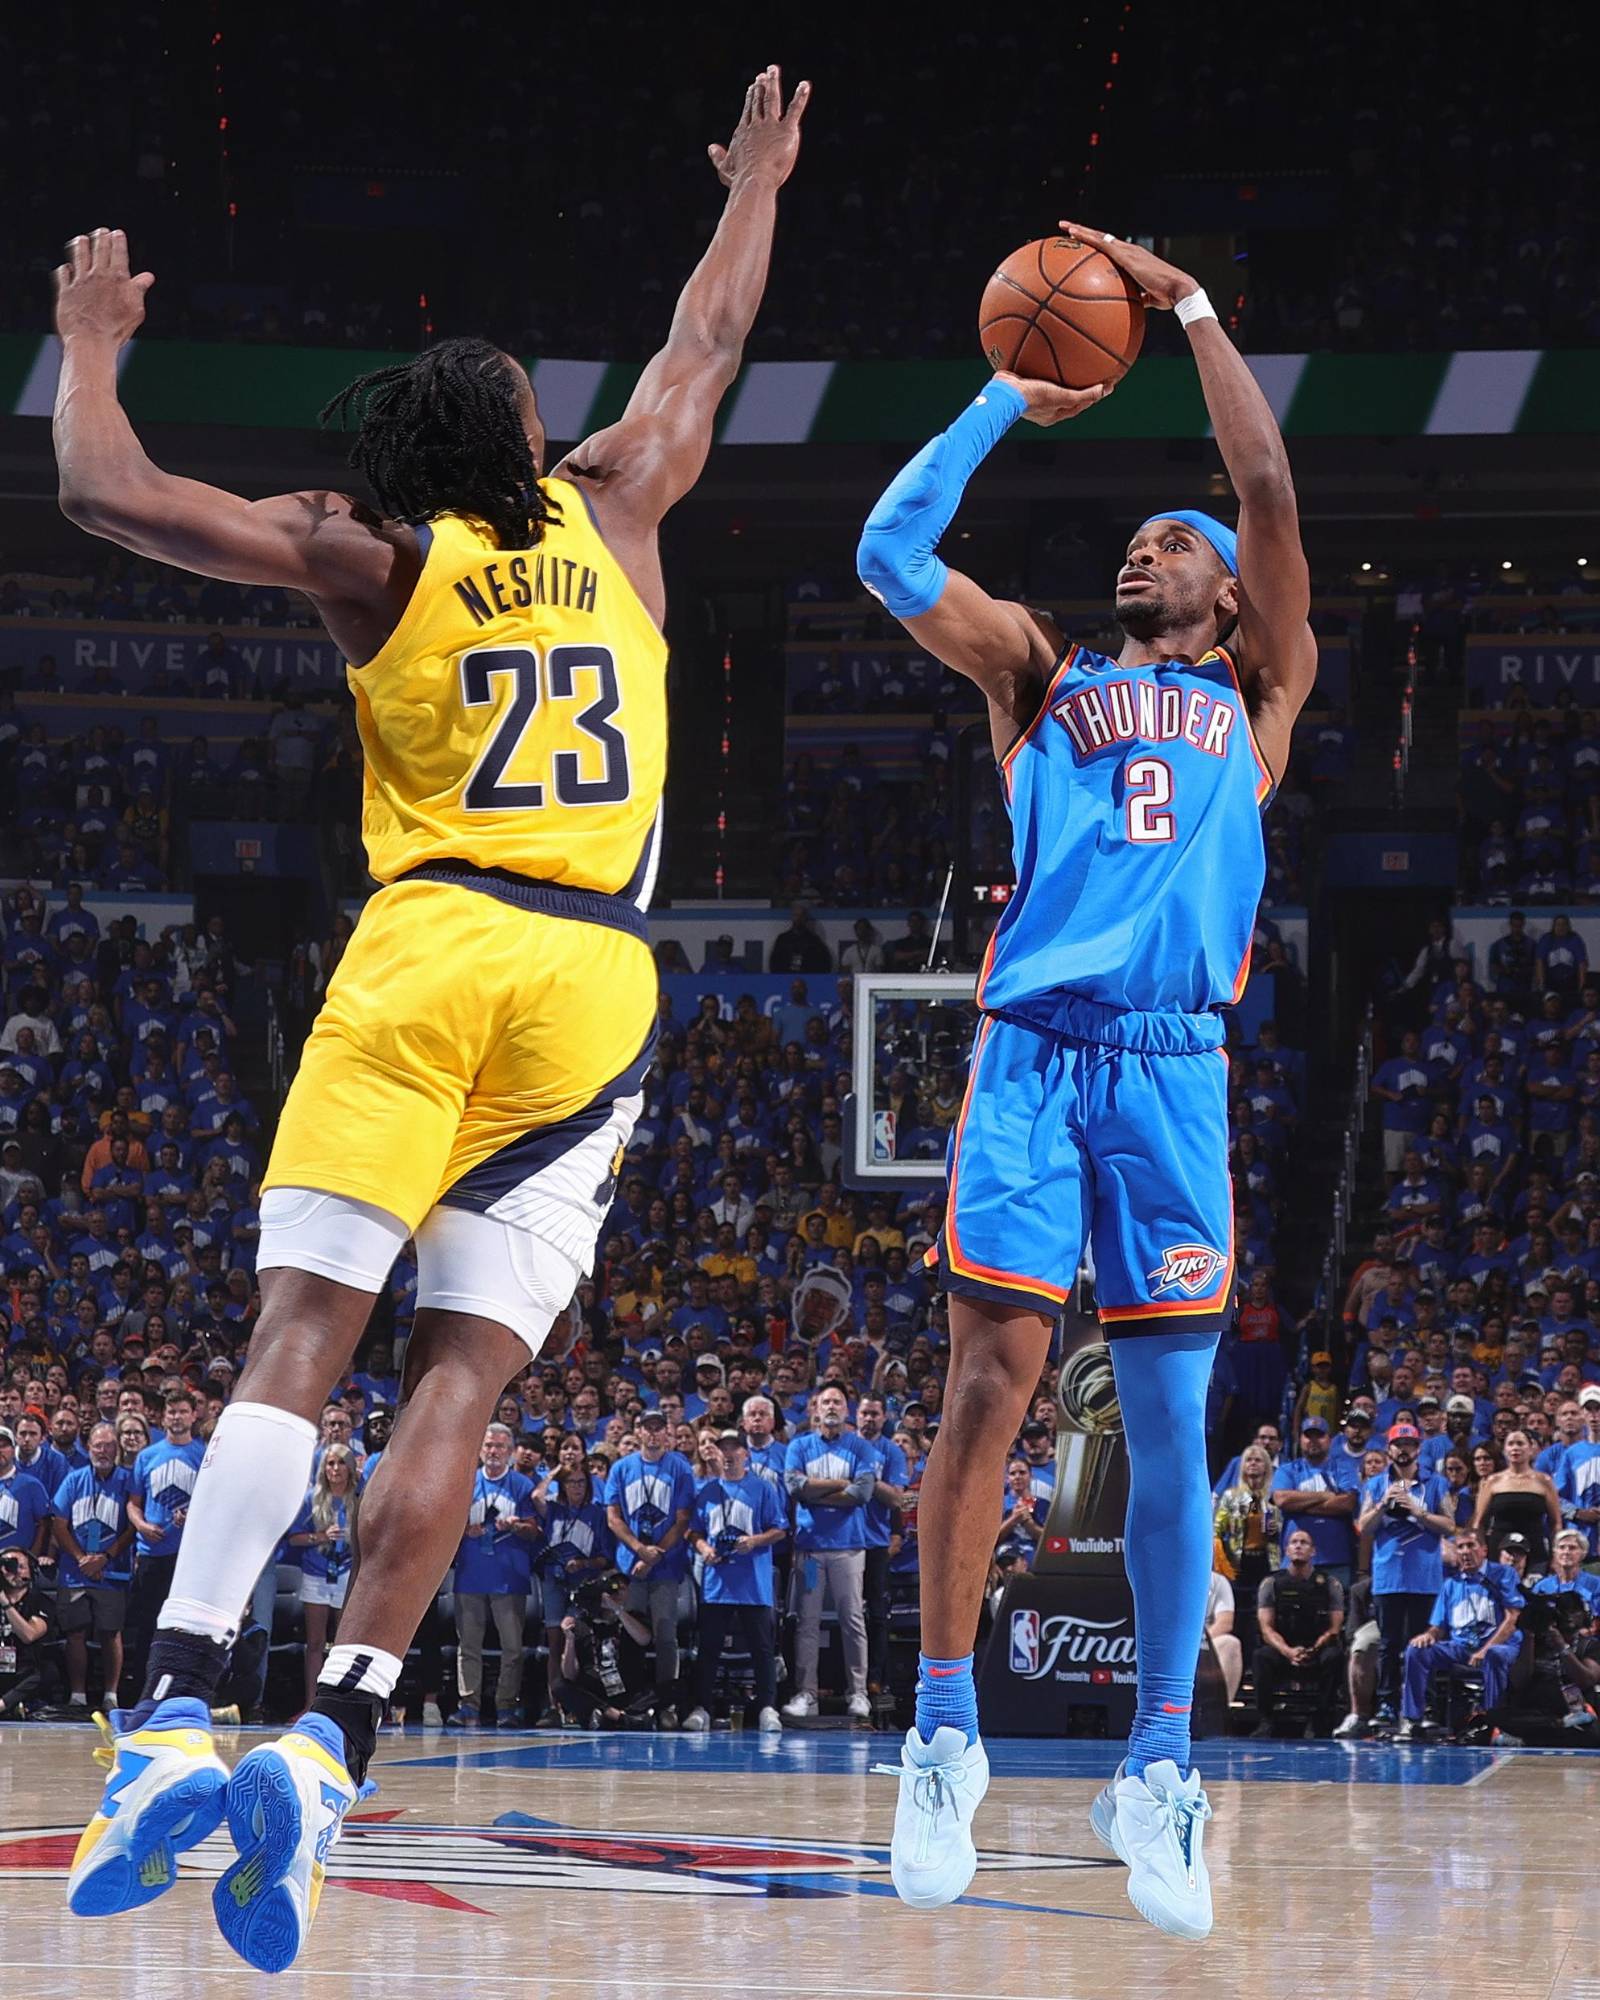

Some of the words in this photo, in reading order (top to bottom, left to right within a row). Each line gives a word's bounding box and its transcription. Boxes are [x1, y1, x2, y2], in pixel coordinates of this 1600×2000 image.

[74, 638, 346, 677] RIVEWIN
[460, 644, 629, 811] 23
[1053, 680, 1235, 759] THUNDER
[1125, 757, 1176, 842] 2
[1164, 1255, 1209, 1283] OKC
[1069, 1537, 1113, 1553] YouTube
